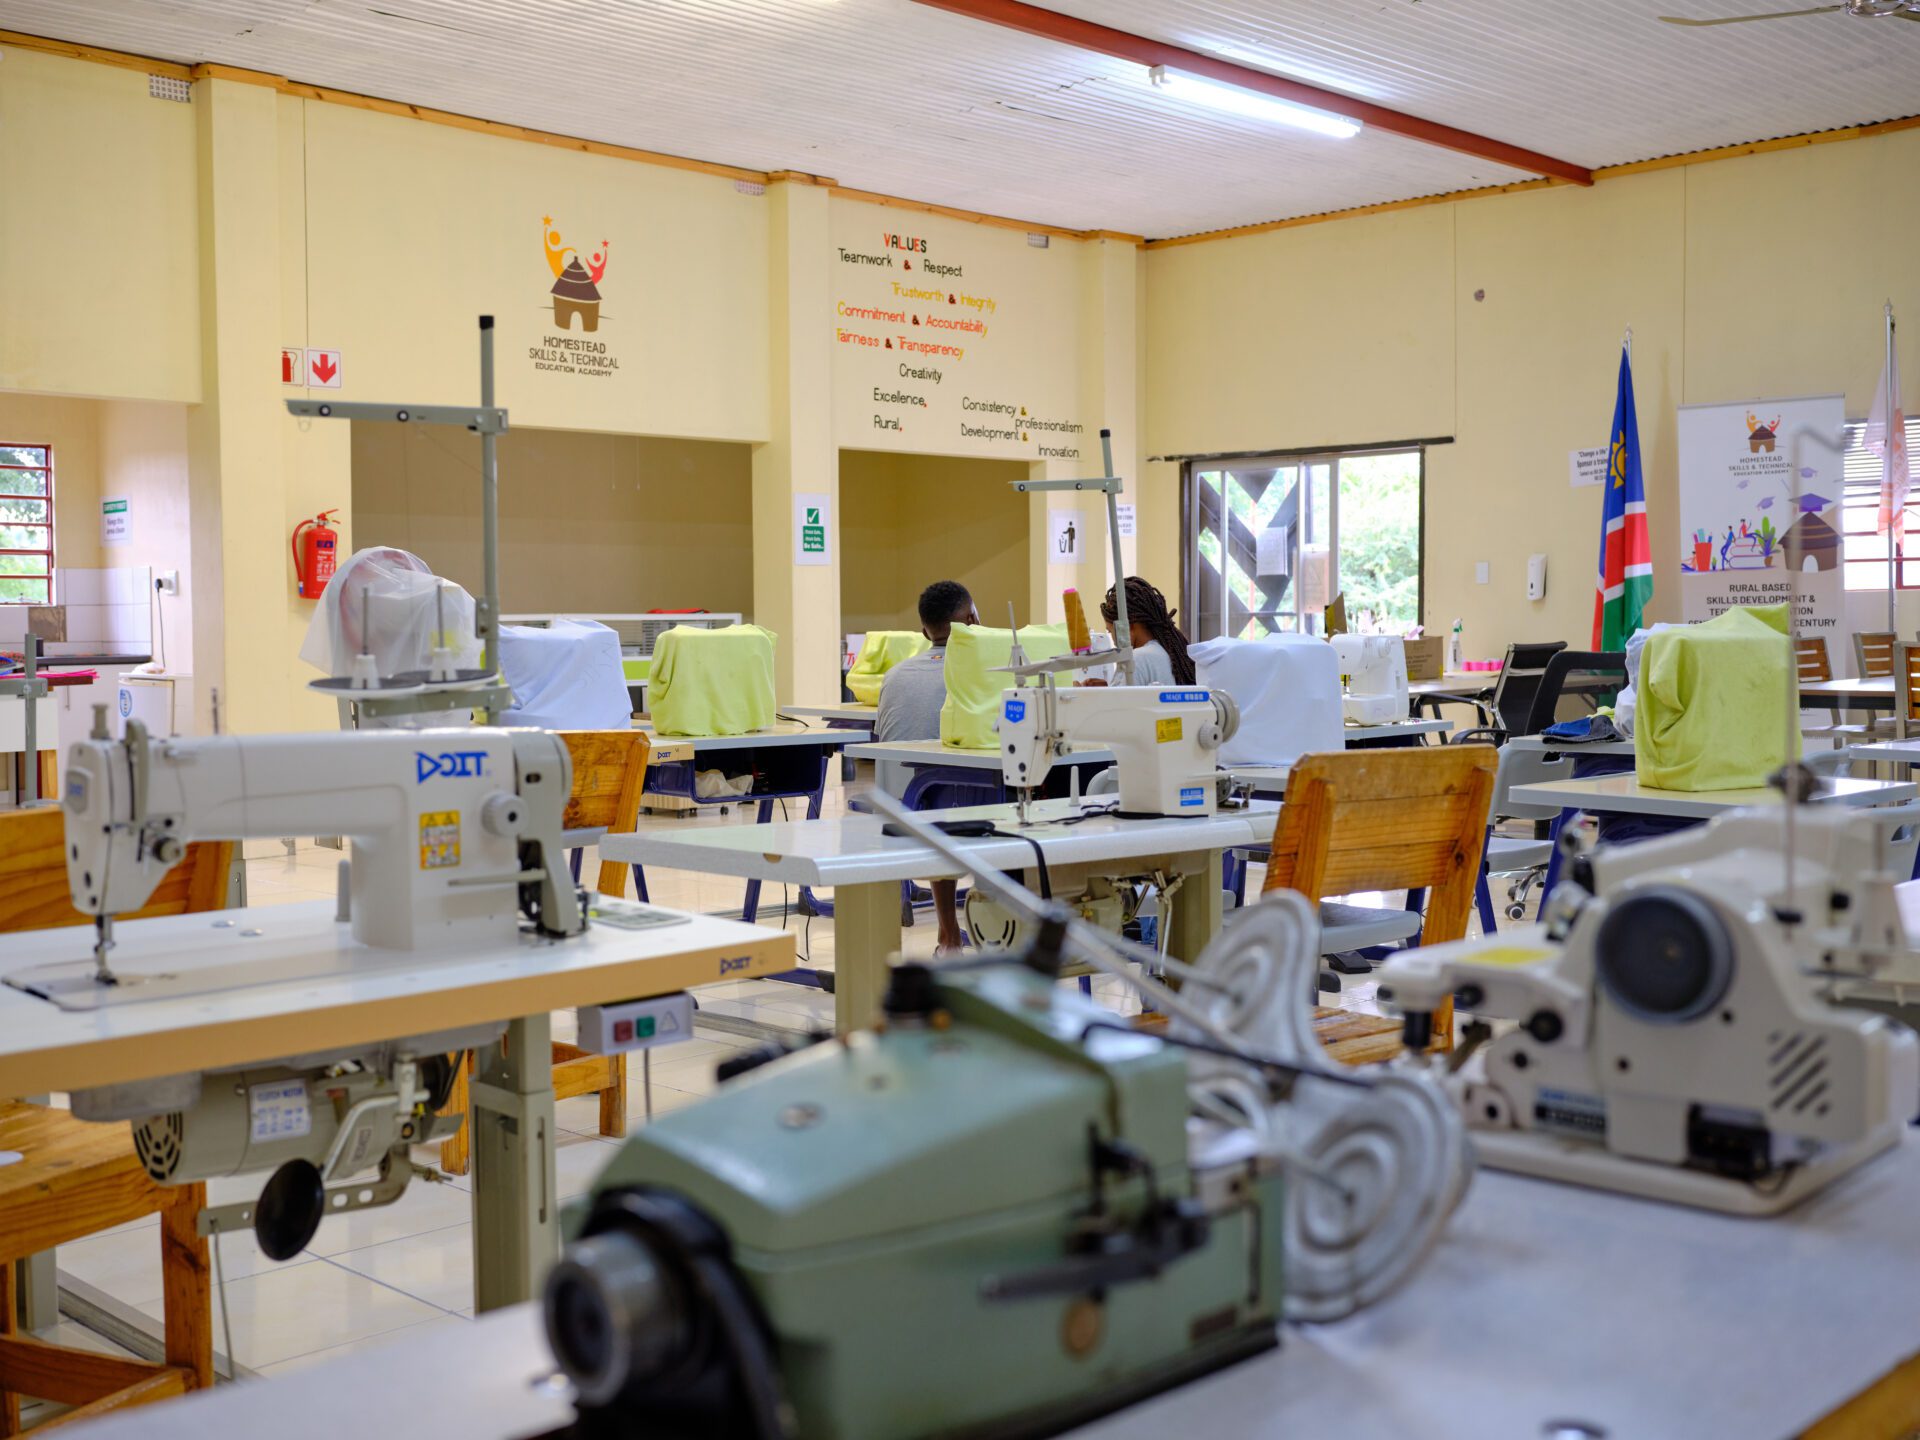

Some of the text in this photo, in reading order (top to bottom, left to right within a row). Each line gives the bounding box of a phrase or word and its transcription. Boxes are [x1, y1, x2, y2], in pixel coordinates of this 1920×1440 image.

[883, 233, 927, 254] VALUES
[838, 248, 963, 277] Teamwork & Respect
[891, 281, 996, 314] Trustworth & Integrity
[837, 301, 988, 338] Commitment & Accountability
[543, 335, 606, 354] HOMESTEAD
[836, 328, 965, 361] Fairness & Transparency
[529, 347, 619, 369] SKILLS & TECHNICAL
[535, 362, 612, 377] EDUCATION ACADEMY
[899, 363, 942, 384] Creativity
[962, 396, 1028, 418] Consistency &
[961, 422, 1028, 442] Development &
[1038, 443, 1079, 458] Innovation
[1740, 455, 1783, 464] HOMESTEAD
[1729, 583, 1792, 592] RURAL BASED
[1706, 594, 1816, 605] SKILLS DEVELOPMENT &
[1794, 618, 1837, 627] CENTURY
